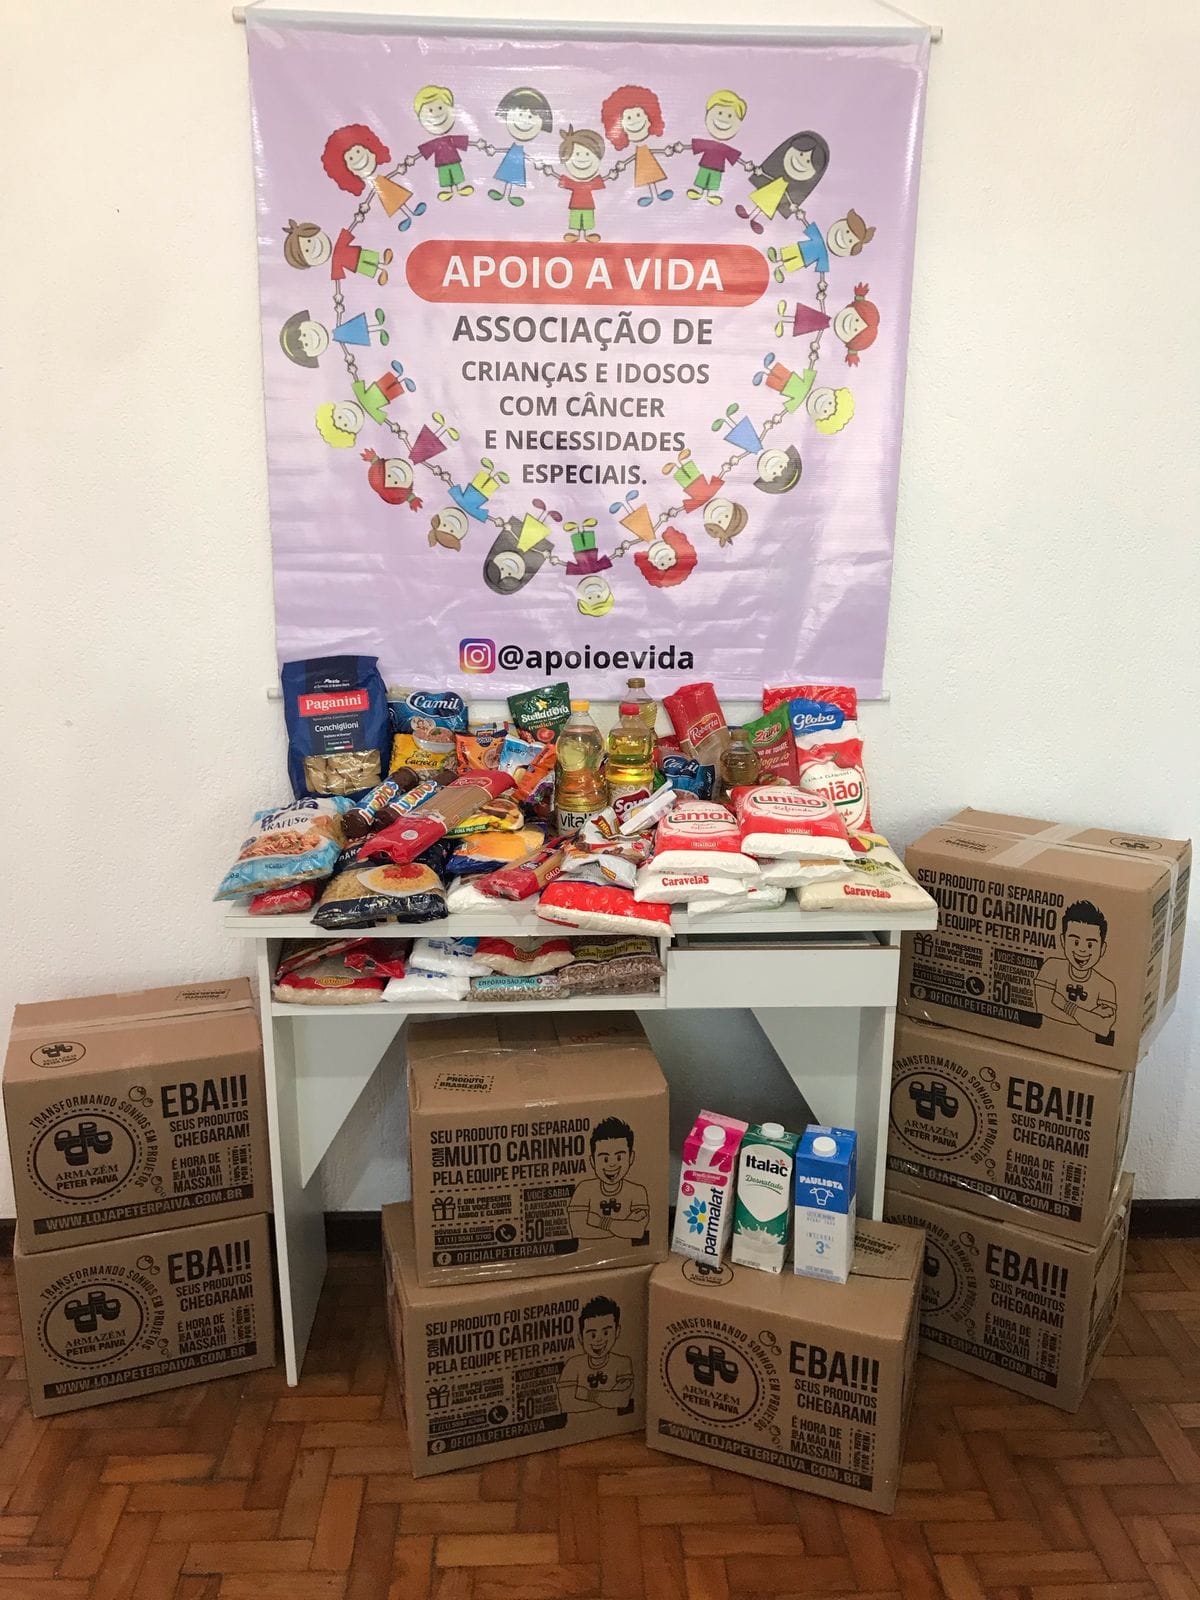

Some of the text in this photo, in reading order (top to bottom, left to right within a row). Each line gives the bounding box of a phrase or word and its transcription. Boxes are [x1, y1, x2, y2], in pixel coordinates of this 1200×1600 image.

[442, 255, 725, 292] APOIO A VIDA
[452, 311, 713, 352] ASSOCIAÇÃO DE
[461, 360, 710, 388] CRIANÇAS E IDOSOS
[499, 391, 665, 418] COM CÂNCER
[485, 430, 686, 452] E NECESSIDADES
[522, 464, 648, 485] ESPECIAIS.
[498, 645, 695, 676] @apoioevida
[305, 694, 362, 711] Paganini
[414, 695, 460, 710] Camil
[314, 721, 359, 733] Conchiglioni
[793, 713, 836, 730] Globo
[673, 811, 732, 821] amor
[661, 874, 710, 887] Caravelas
[917, 868, 1065, 908] SEU PRODUTO FOI SEPARADO
[931, 890, 1058, 931] MUITO CARINHO
[944, 916, 1058, 950] EQUIPE PETER PAIVA
[992, 980, 1011, 1005] 50
[930, 991, 1020, 1022] OFICIALPETERPAIVA
[439, 1081, 489, 1090] BRASILEIRO
[445, 1076, 485, 1085] PRODUTO
[968, 1072, 995, 1110] SONHOS
[160, 1074, 249, 1119] EBA!!!
[1006, 1076, 1095, 1127] EBA!!!
[169, 1110, 250, 1133] SEUS PRODUTOS
[430, 1117, 591, 1146] SEU PRODUTO FOI SEPARADO
[904, 1119, 960, 1140] ARMAZÉM
[986, 1112, 998, 1126] EM
[1011, 1113, 1091, 1142] SEUS PRODUTOS
[29, 1094, 158, 1189] TRANSFORMANDO SONHOS EM PROJETOS
[174, 1123, 251, 1149] CHEGARAM!
[904, 1126, 958, 1149] PETER PAIVA
[970, 1128, 998, 1164] PROJETOS
[1012, 1127, 1090, 1158] CHEGARAM!
[179, 1154, 206, 1170] HORA
[207, 1152, 221, 1166] DE
[431, 1135, 586, 1168] COM MUITO CARINHO
[1014, 1151, 1041, 1168] HORA
[1042, 1158, 1056, 1172] DE
[55, 1163, 120, 1182] ARMAZÉM
[187, 1164, 222, 1180] MÃO NA
[433, 1158, 587, 1186] PELA EQUIPE PETER PAIVA
[745, 1154, 789, 1178] Italac
[1020, 1163, 1053, 1183] MÃO NA
[56, 1173, 119, 1191] PETER PAIVA
[173, 1174, 223, 1194] MASSA!!!
[799, 1175, 844, 1191] PAULISTA
[1004, 1171, 1053, 1196] MASSA!!!
[46, 1188, 244, 1231] WWW.LOJAPETERPAIVA.COM.BR
[704, 1187, 725, 1257] parmalat
[525, 1219, 545, 1242] 50
[167, 1240, 251, 1285] EBA!!!
[456, 1244, 555, 1263] OFICIALPETERPAIVA
[39, 1265, 125, 1300] TRANSFORMANDO
[985, 1243, 1069, 1299] EBA!!!
[175, 1273, 253, 1297] SEUS PRODUTOS
[989, 1278, 1066, 1313] SEUS PRODUTOS
[180, 1285, 254, 1312] CHEGARAM!
[990, 1292, 1065, 1329] CHEGARAM!
[185, 1313, 225, 1331] HORA DE
[426, 1298, 580, 1337] SEU PRODUTO FOI SEPARADO
[64, 1329, 127, 1348] ARMAZÉM
[439, 1315, 575, 1356] MUITO CARINHO
[666, 1318, 749, 1343] TRANSFORMANDO
[66, 1339, 127, 1357] PETER PAIVA
[178, 1334, 228, 1355] MASSA!!!
[428, 1336, 576, 1376] PELA EQUIPE PETER PAIVA
[748, 1340, 778, 1375] SONHOS
[789, 1340, 880, 1394] EBA!!!
[681, 1384, 742, 1406] ARMAZÉM
[682, 1392, 740, 1415] PETER PAIVA
[794, 1378, 878, 1409] SEUS PRODUTOS
[753, 1393, 781, 1432] PROJETOS
[797, 1392, 877, 1427] CHEGARAM!
[799, 1418, 828, 1435] HORA
[829, 1426, 843, 1440] DE
[669, 1423, 862, 1487] WWW.LOJAPETERPAIVA.COM.BR
[790, 1440, 842, 1465] MASSA!!!
